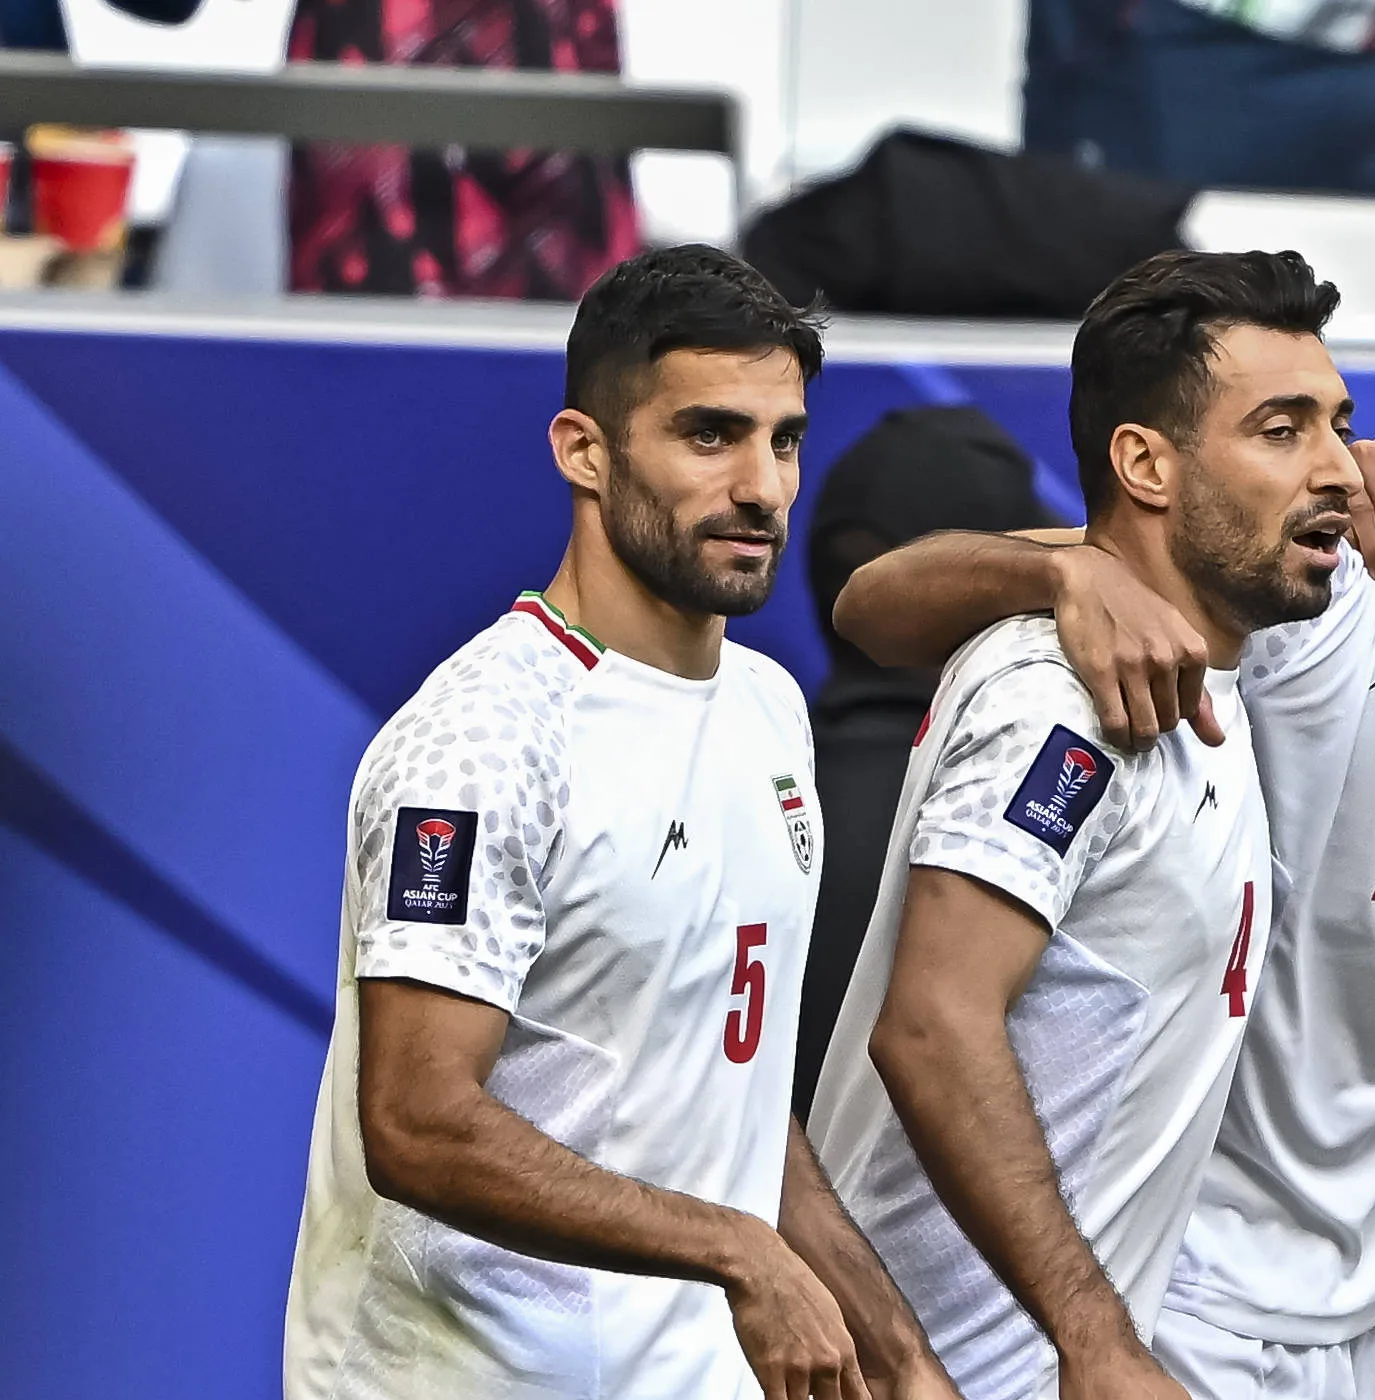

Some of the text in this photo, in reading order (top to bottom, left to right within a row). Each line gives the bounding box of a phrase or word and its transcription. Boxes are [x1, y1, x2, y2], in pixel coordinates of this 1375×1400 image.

[1025, 799, 1074, 832] ASIAN CUP
[402, 889, 458, 902] ASIAN CUP
[422, 883, 440, 892] AFC
[404, 898, 433, 909] QATAR
[1220, 881, 1253, 1017] 4
[723, 922, 767, 1065] 5
